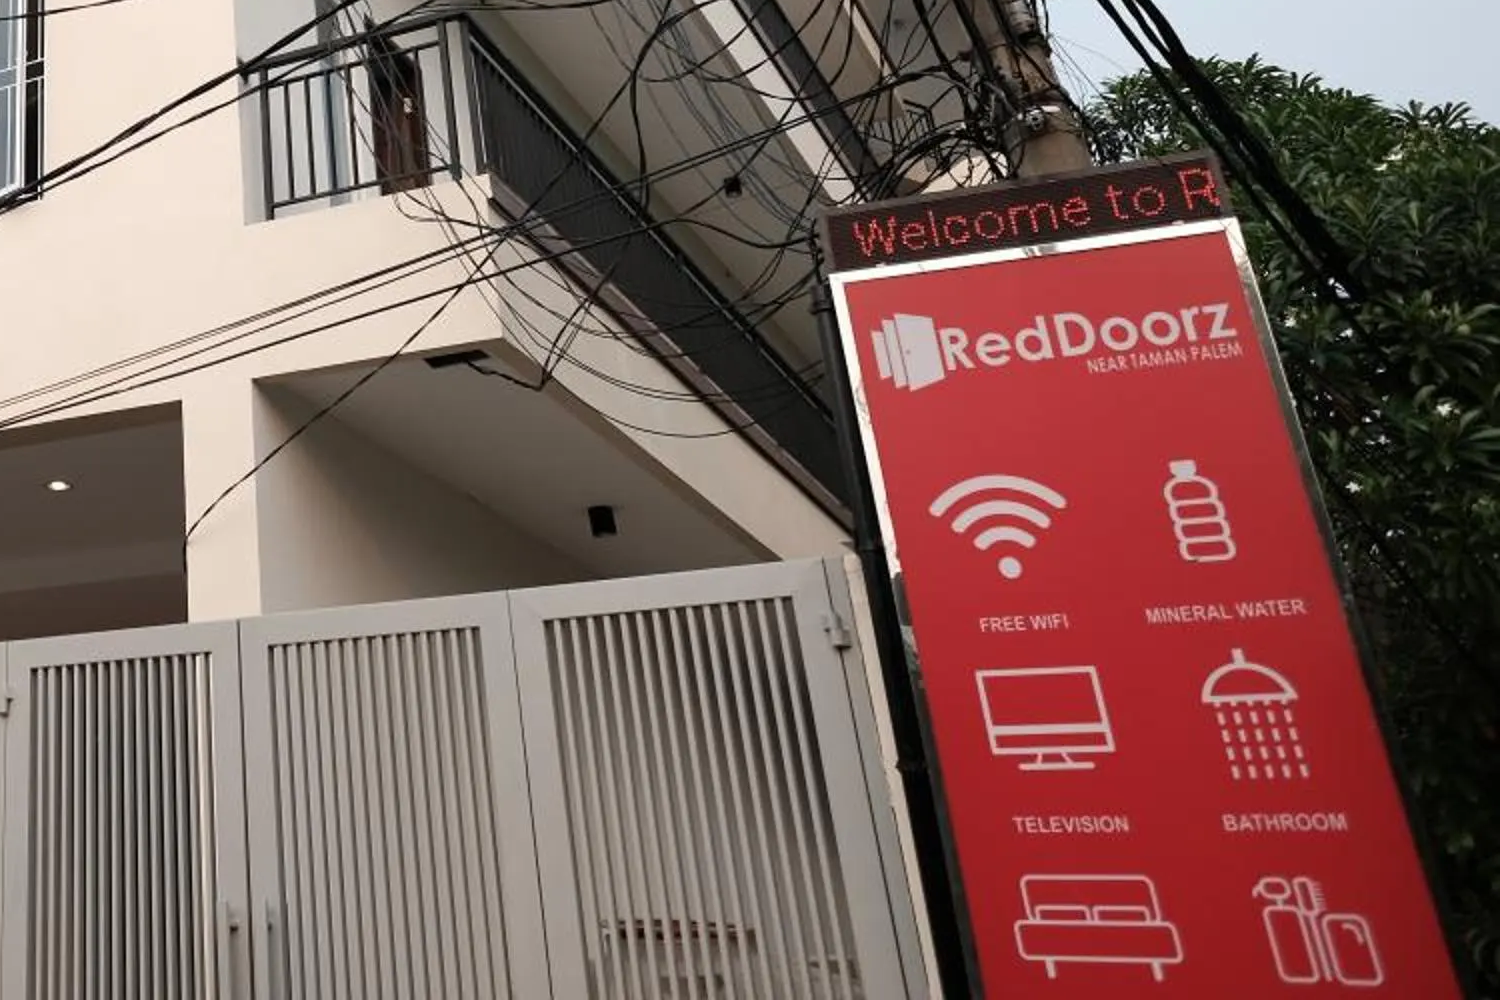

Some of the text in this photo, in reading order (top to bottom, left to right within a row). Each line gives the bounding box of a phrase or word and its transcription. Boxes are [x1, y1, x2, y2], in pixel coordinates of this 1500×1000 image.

[852, 167, 1221, 257] Welcome to R
[937, 303, 1238, 371] RedDoorz
[1087, 342, 1243, 374] NEAR TAMAN PALEM
[979, 613, 1069, 632] FREE WIFI
[1145, 599, 1306, 624] MINERAL WATER
[1012, 815, 1130, 833] TELEVISION
[1222, 813, 1348, 832] BATHROOM
